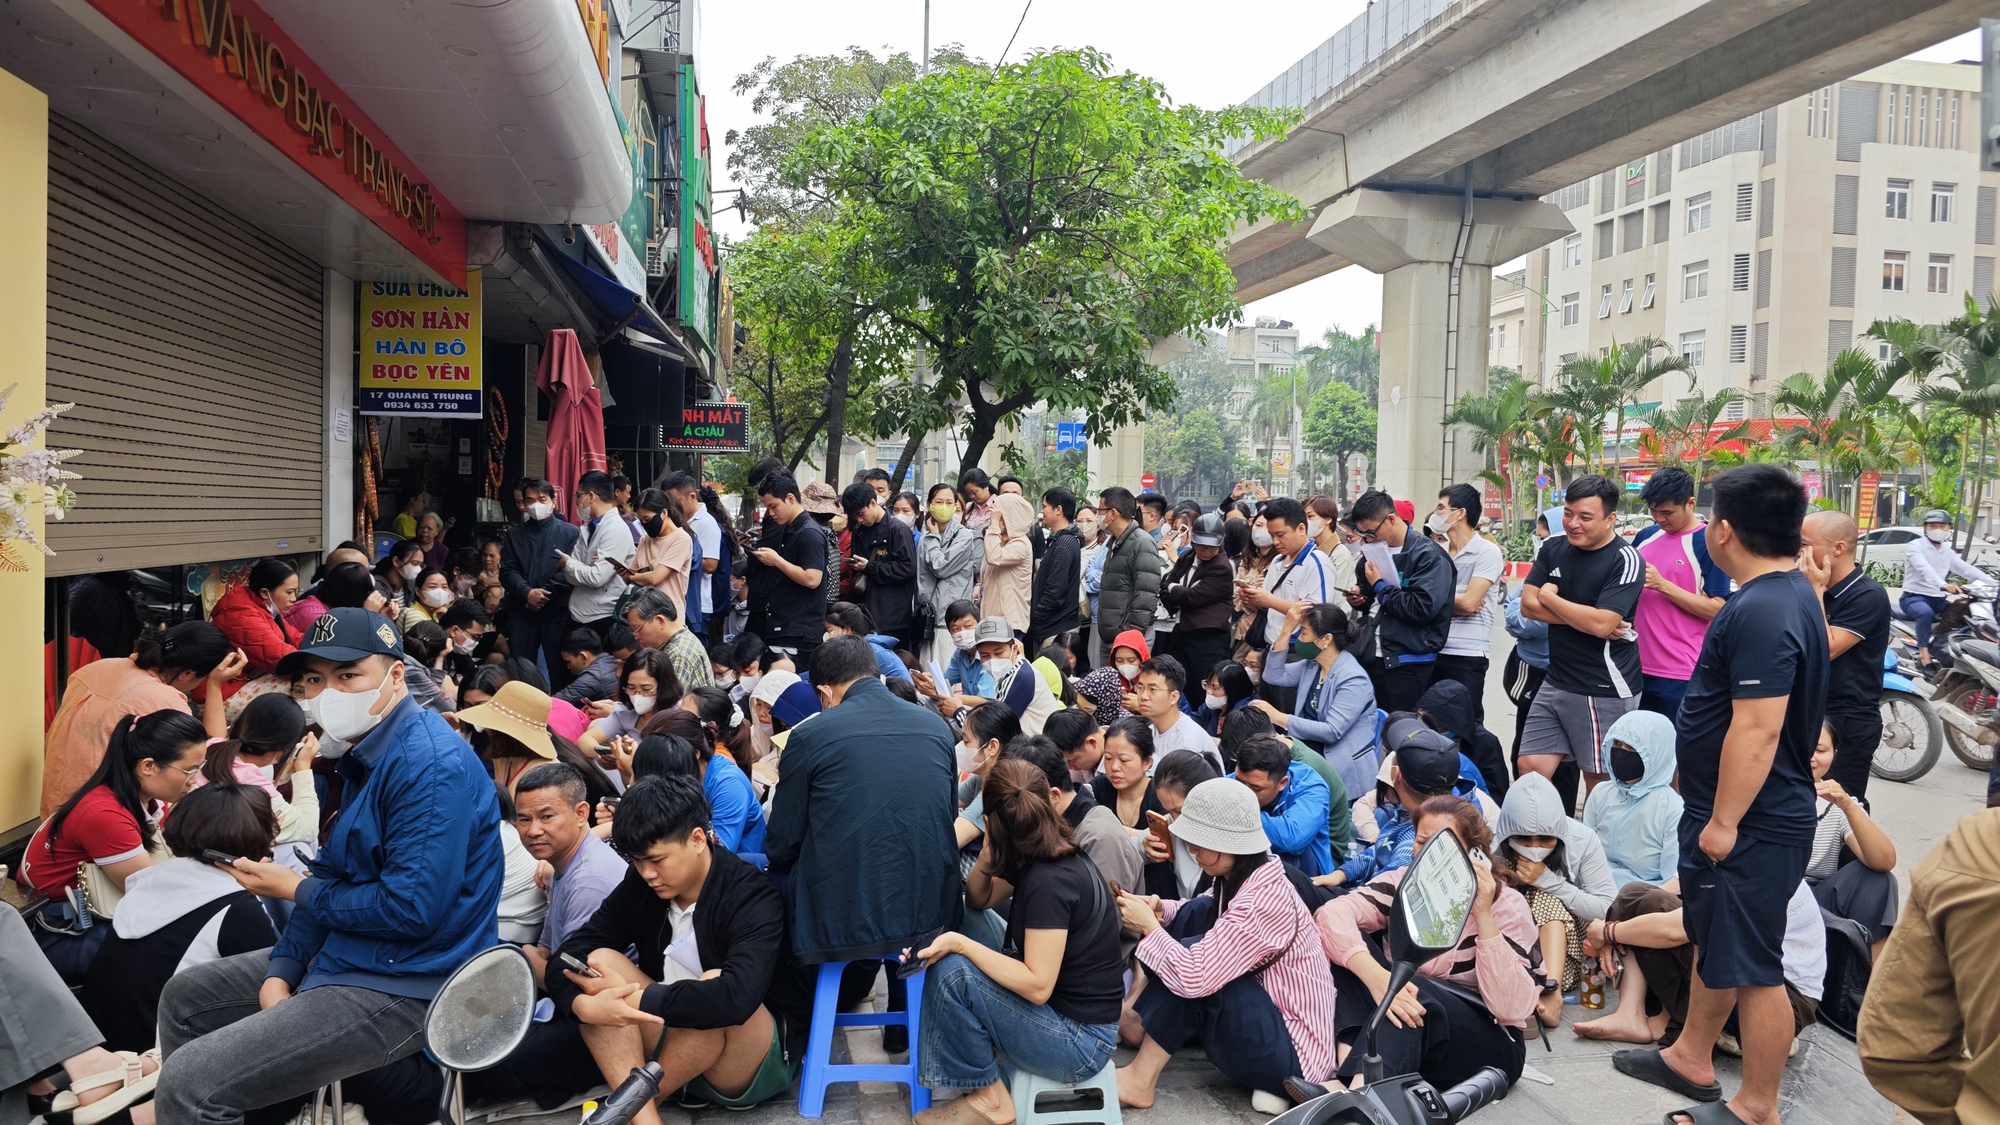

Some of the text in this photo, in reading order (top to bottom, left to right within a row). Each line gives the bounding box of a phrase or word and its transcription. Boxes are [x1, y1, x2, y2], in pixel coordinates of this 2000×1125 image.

[295, 67, 343, 159] BẠC
[348, 118, 412, 219] TRANG
[371, 306, 471, 330] SƠN HÀN
[376, 337, 427, 355] HÀN
[372, 362, 471, 382] BỌC YÊN
[369, 391, 473, 401] 17 QUANG TRUNG
[383, 401, 459, 410] 0934 633 750
[694, 425, 725, 437] CHÂU
